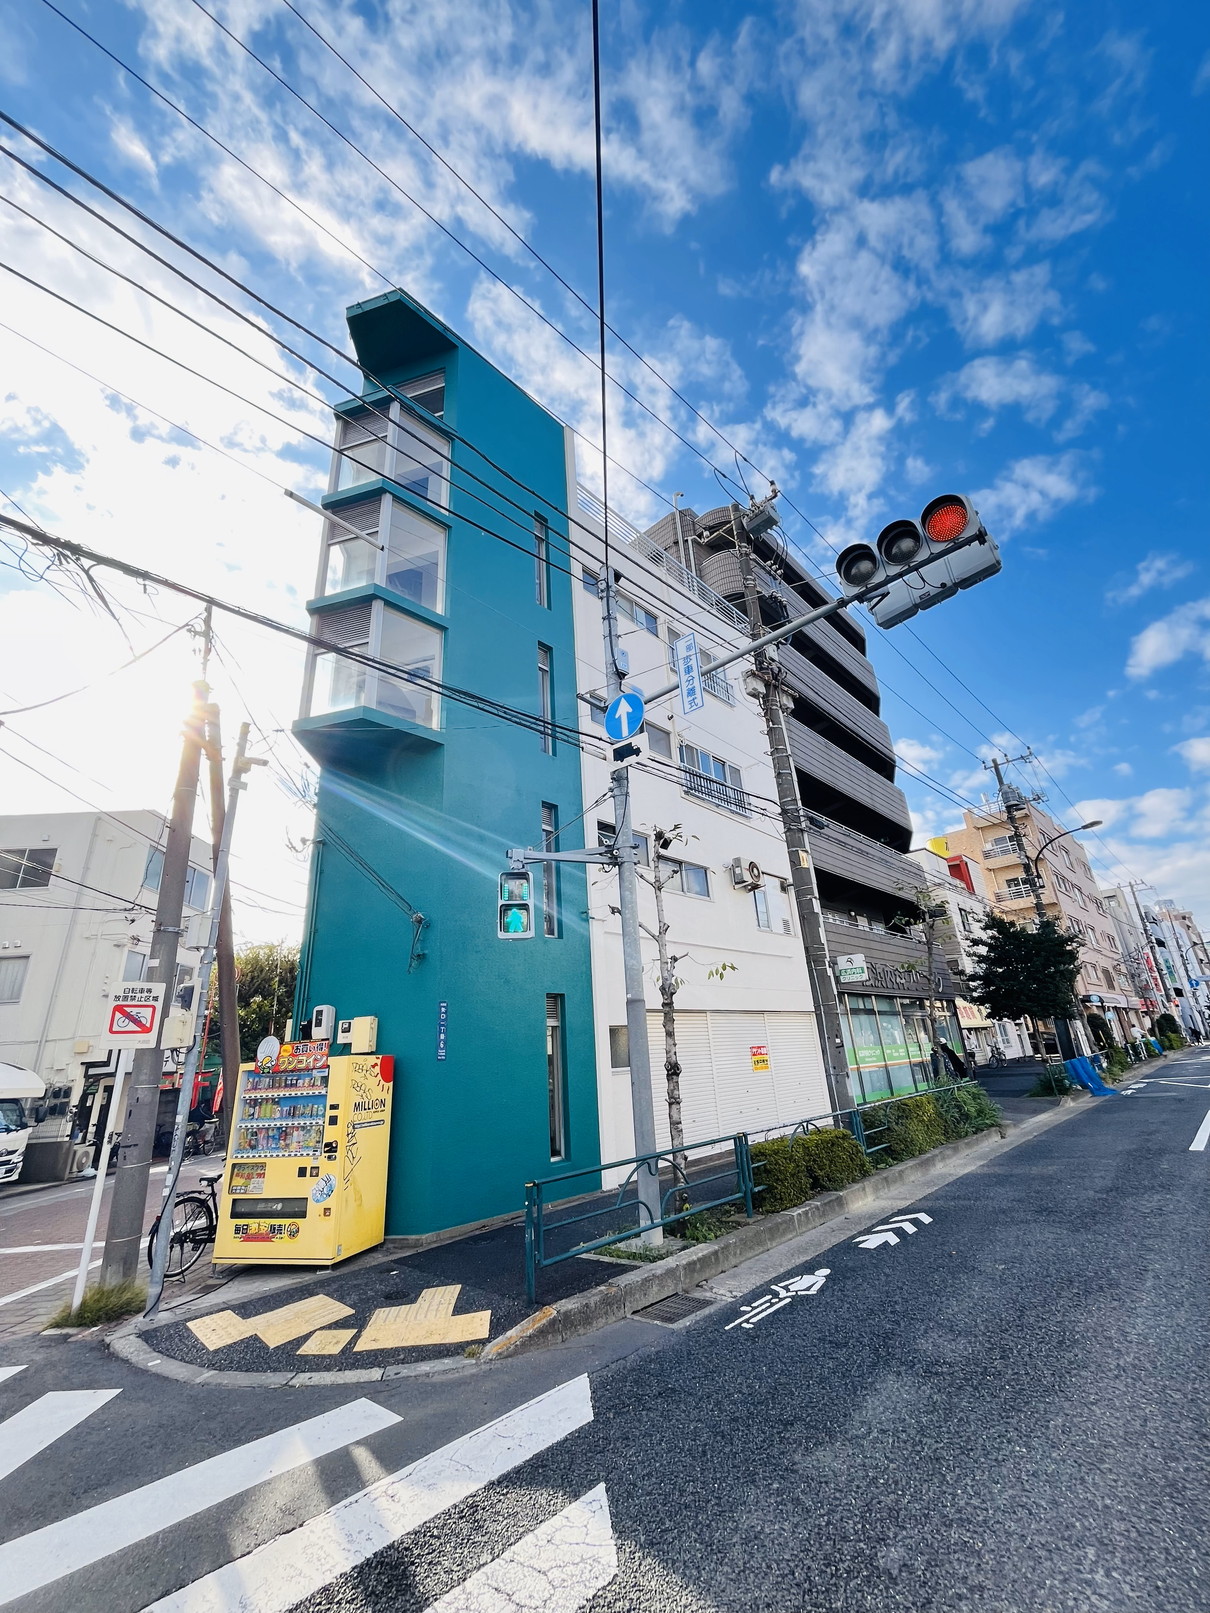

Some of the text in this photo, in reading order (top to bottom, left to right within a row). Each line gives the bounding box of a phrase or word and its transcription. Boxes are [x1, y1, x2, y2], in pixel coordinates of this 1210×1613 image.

[123, 987, 153, 995] 自転車等
[113, 994, 159, 1002] 放置禁止区域
[279, 1053, 327, 1070] ワンコイン
[353, 1098, 386, 1113] MILLION
